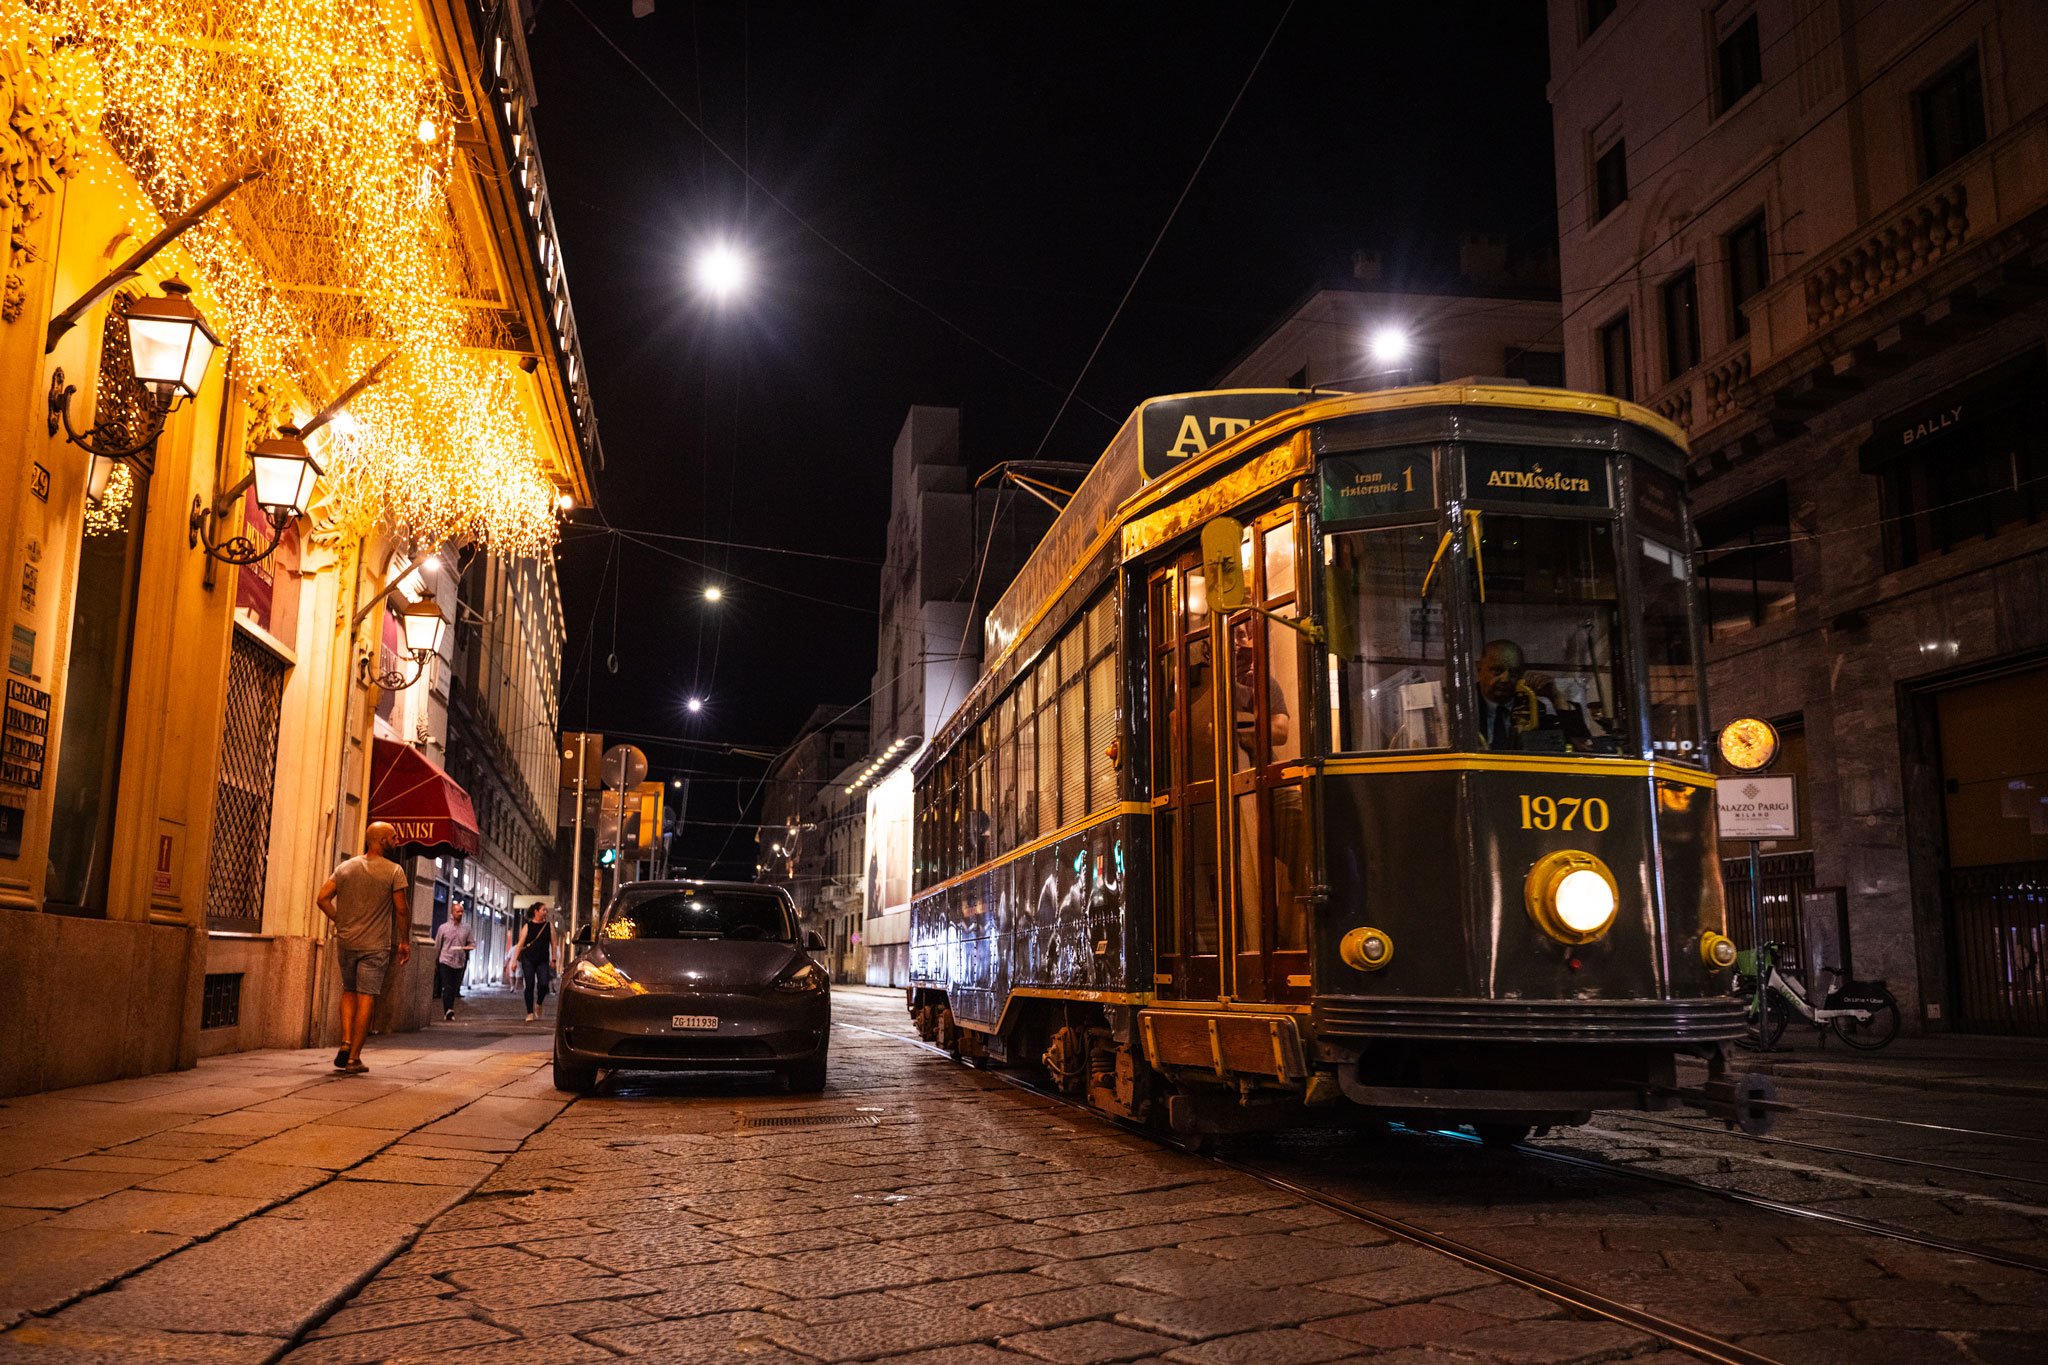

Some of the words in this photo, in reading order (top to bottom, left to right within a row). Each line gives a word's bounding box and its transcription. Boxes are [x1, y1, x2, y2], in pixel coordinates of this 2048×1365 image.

[1166, 414, 1264, 458] AT
[1903, 406, 1962, 445] BALLY
[32, 466, 49, 498] 29
[1340, 482, 1399, 498] ristorante
[1354, 471, 1382, 485] tram
[1403, 465, 1414, 493] 1
[1487, 470, 1590, 493] ATMosfera
[1519, 795, 1610, 832] 1970
[1758, 802, 1789, 811] PARIGI
[390, 822, 434, 839] NNISI
